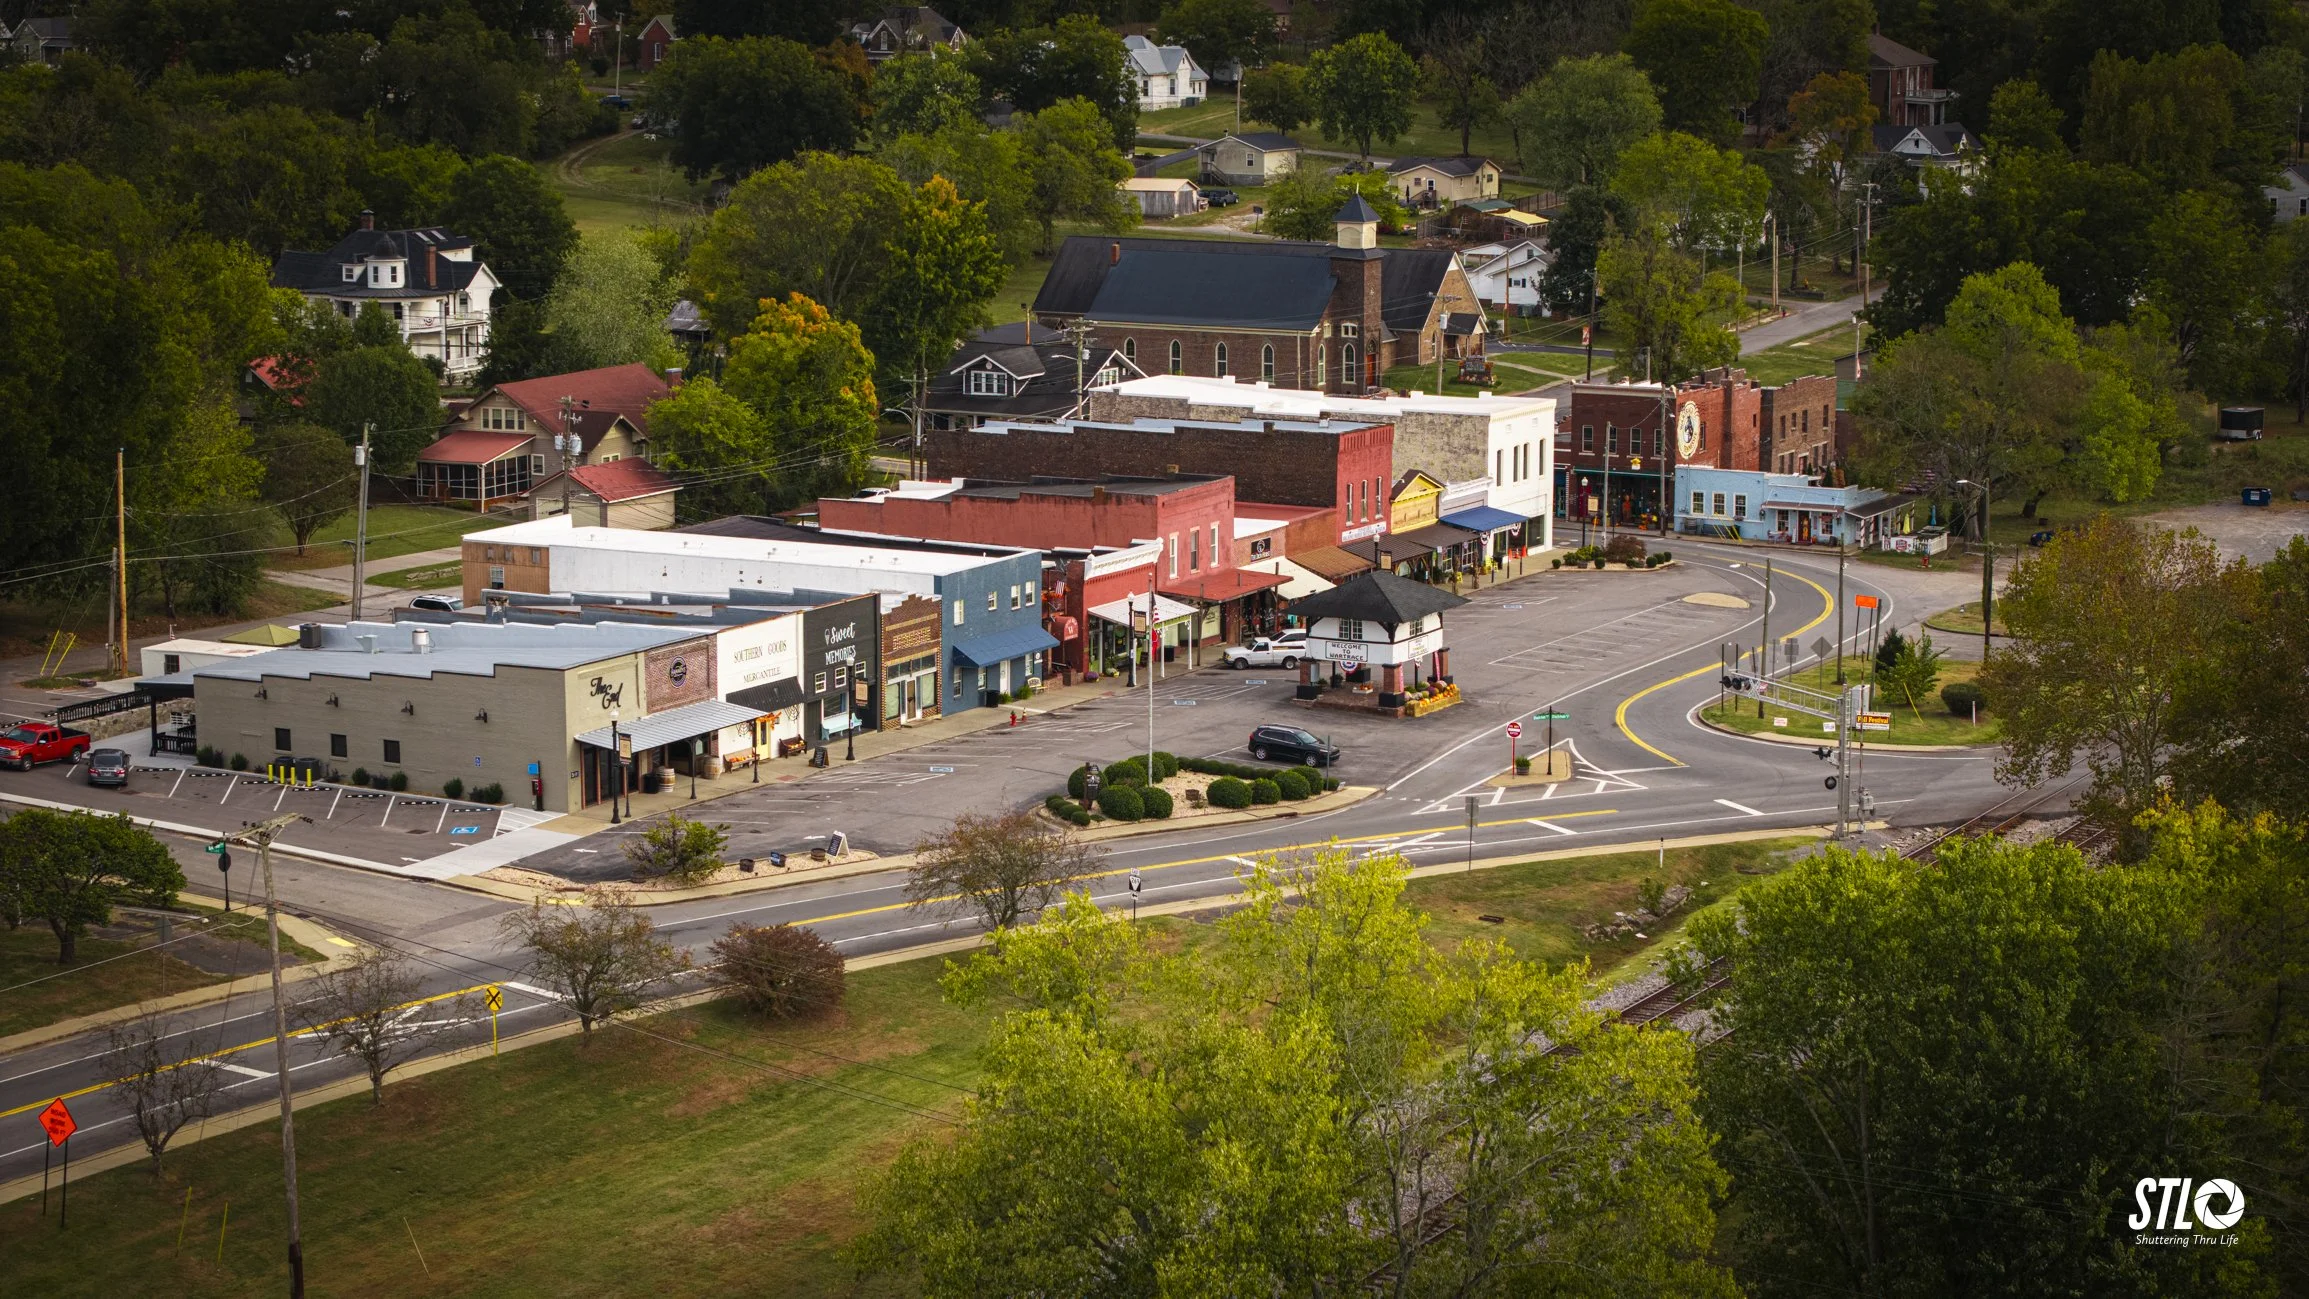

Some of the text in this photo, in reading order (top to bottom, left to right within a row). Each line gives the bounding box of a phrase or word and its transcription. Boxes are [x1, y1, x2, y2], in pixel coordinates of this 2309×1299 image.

[830, 622, 856, 644] Sweet
[733, 640, 787, 664] SOUTHERN GOODS
[825, 645, 857, 666] MEMORIES
[1329, 652, 1364, 661] WARTRACE
[1331, 643, 1362, 651] WELCOME
[743, 666, 781, 683] MERCANTILE
[590, 676, 612, 697] The
[602, 683, 624, 710] End
[1857, 715, 1889, 724] Fll Festival
